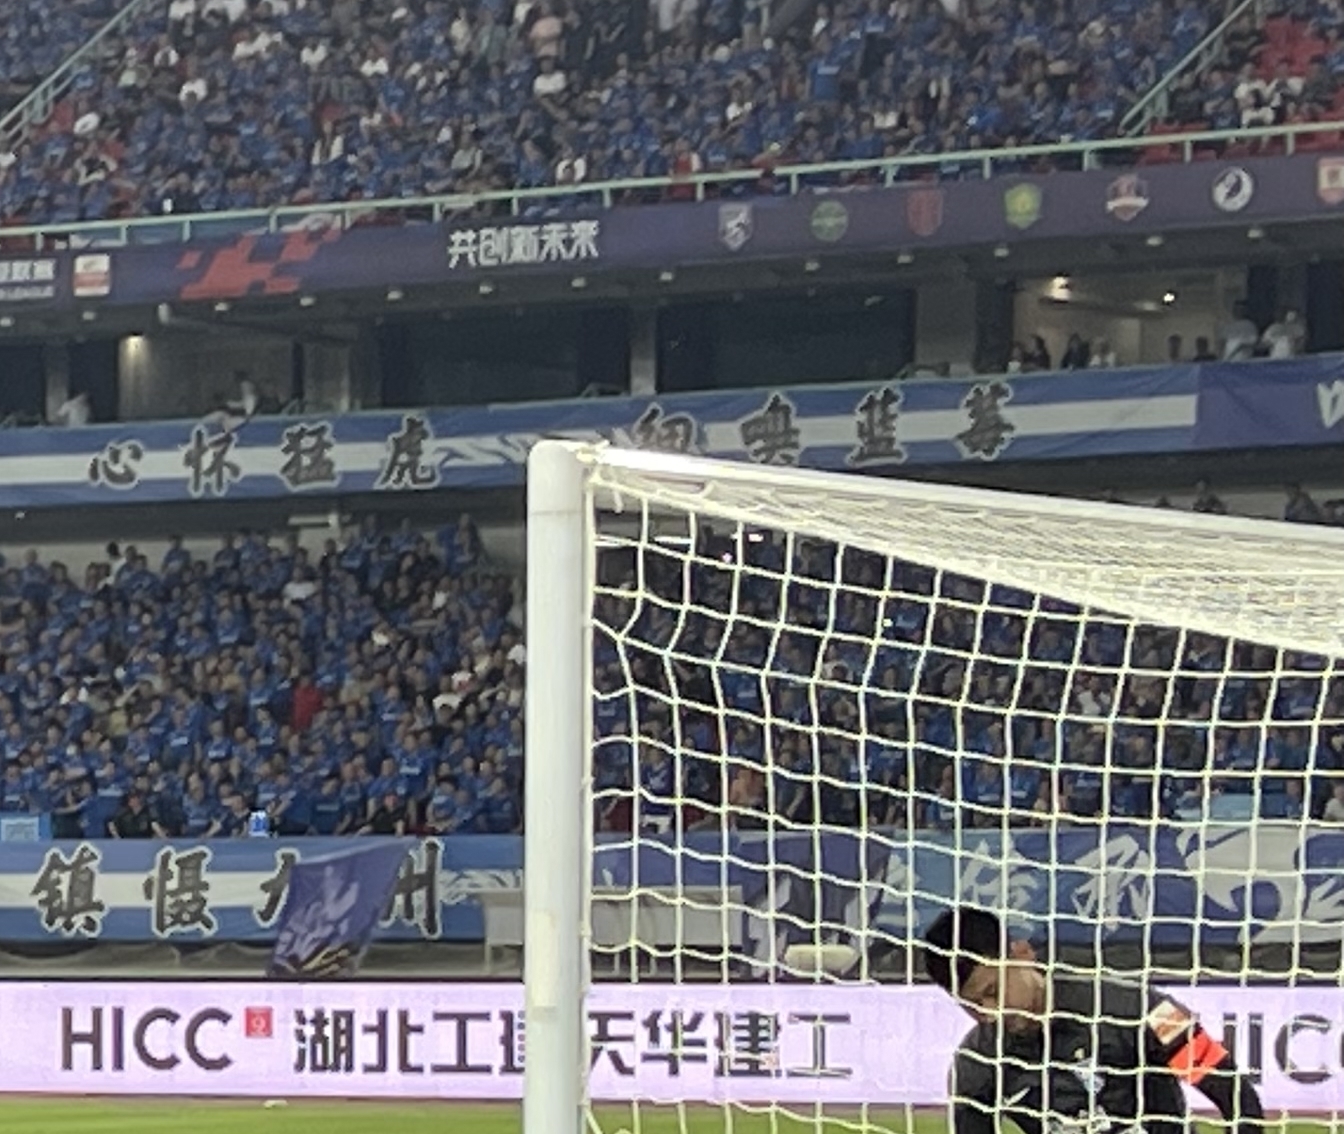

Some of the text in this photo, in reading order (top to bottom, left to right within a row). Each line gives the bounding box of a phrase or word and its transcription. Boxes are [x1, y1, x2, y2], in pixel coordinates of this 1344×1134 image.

[447, 220, 600, 269] 共创新未来
[86, 412, 440, 494] 心怀猛虎
[61, 1006, 233, 1073] HICC
